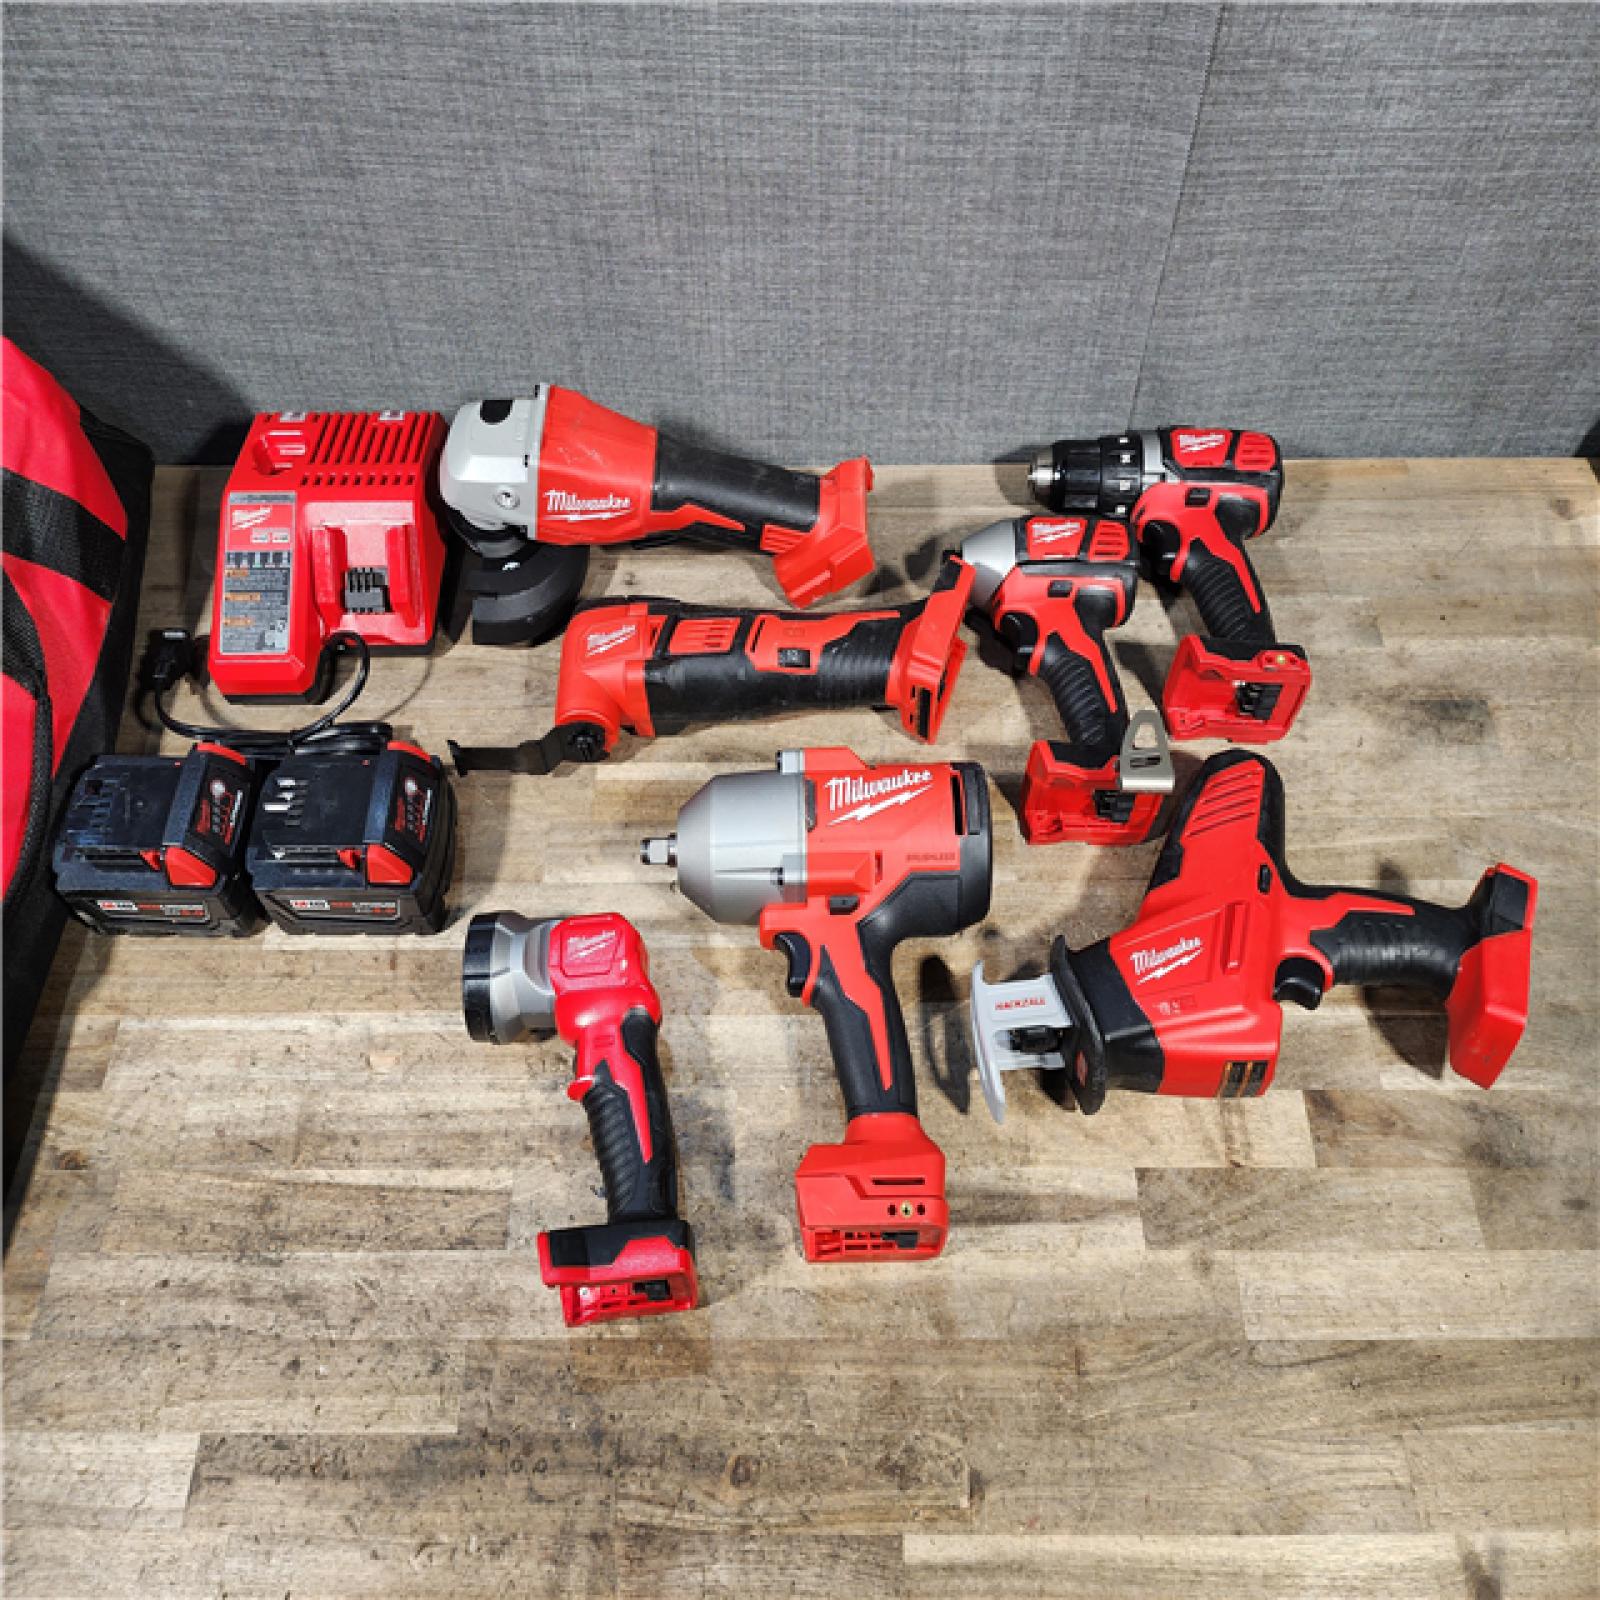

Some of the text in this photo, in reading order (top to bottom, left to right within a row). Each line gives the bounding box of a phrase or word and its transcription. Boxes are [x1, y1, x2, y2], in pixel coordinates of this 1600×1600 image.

[543, 489, 631, 512] Milwaukee
[825, 769, 933, 812] Milwaukee
[1130, 936, 1202, 975] Milwaukee
